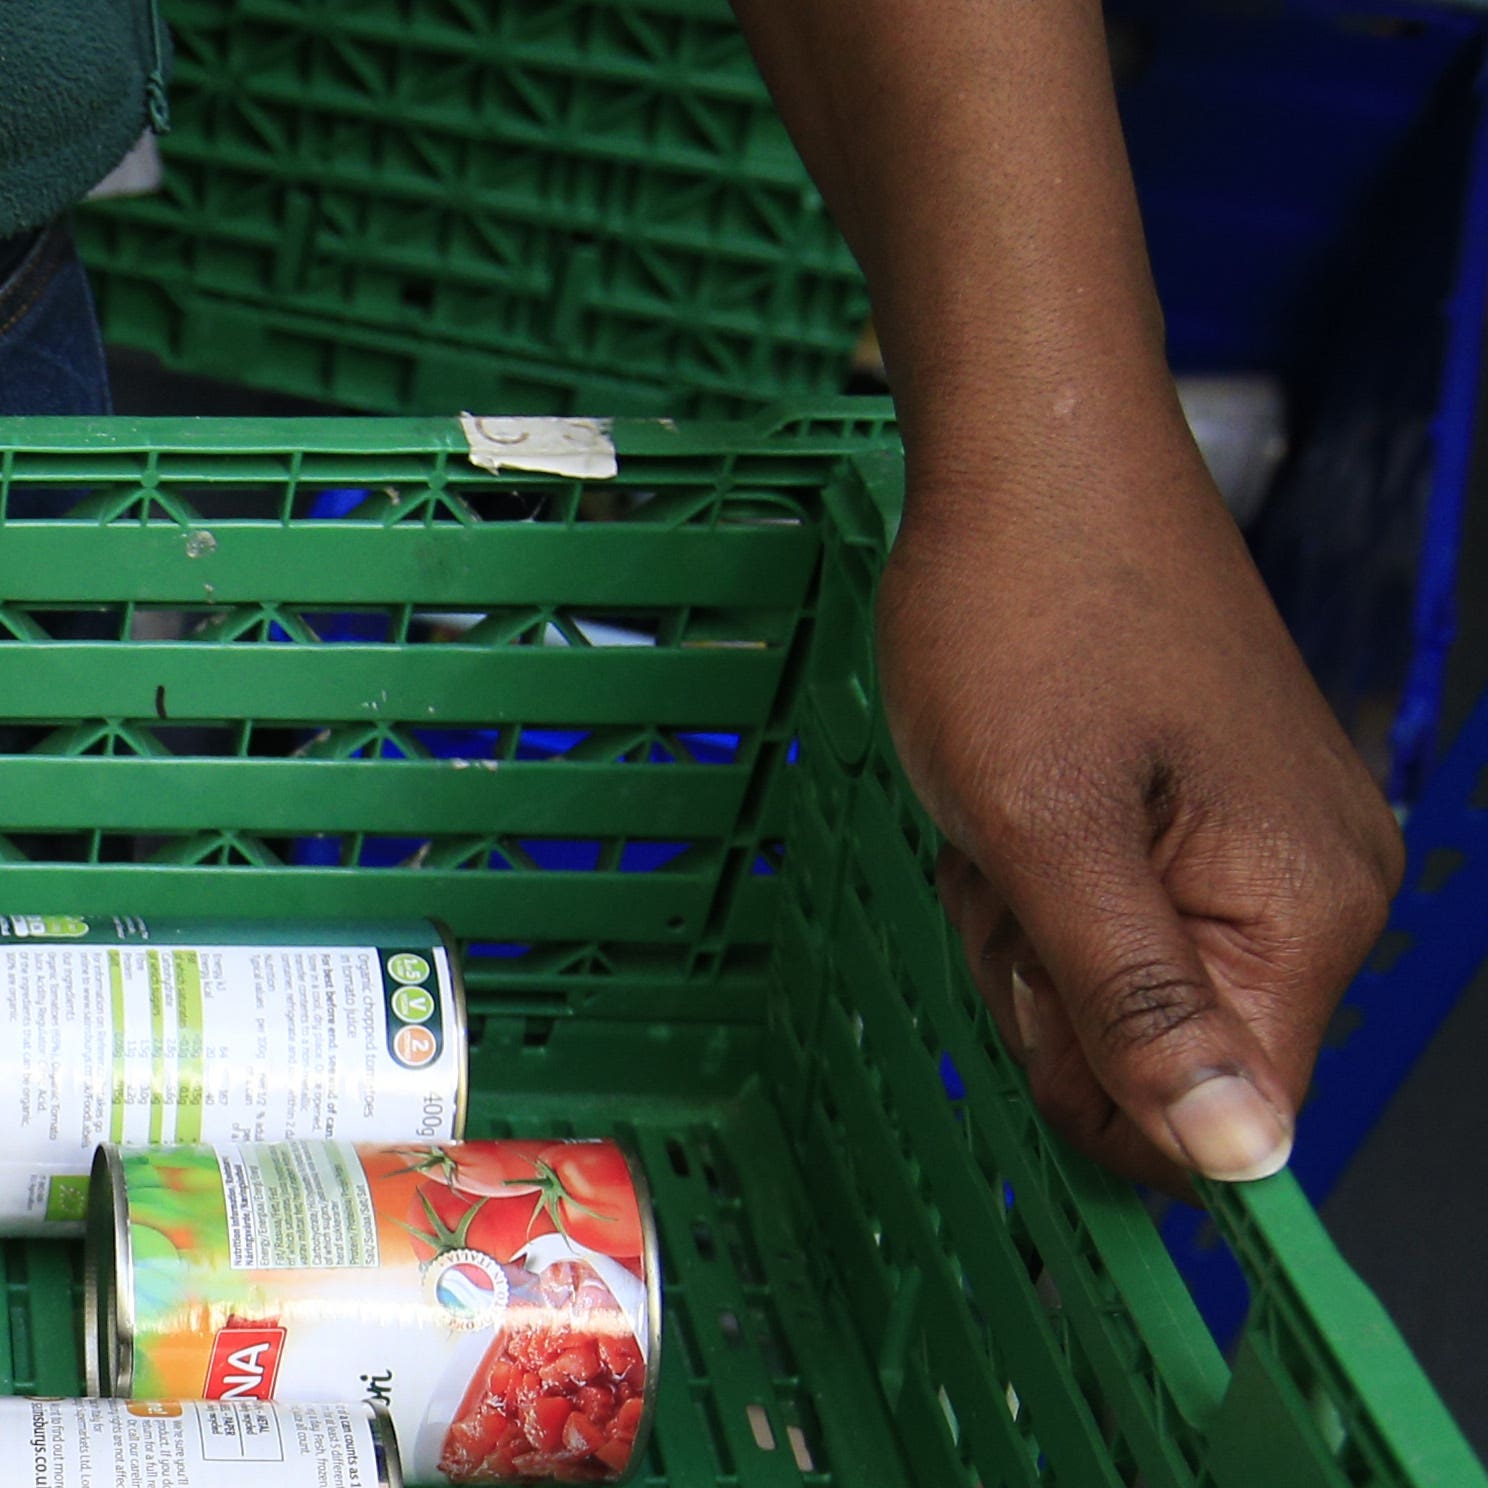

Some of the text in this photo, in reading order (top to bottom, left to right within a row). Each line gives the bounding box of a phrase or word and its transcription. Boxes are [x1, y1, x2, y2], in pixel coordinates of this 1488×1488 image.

[326, 991, 336, 1023] before
[343, 1435, 357, 1465] counts
[174, 1460, 188, 1485] you'll
[318, 1458, 329, 1488] frozen,
